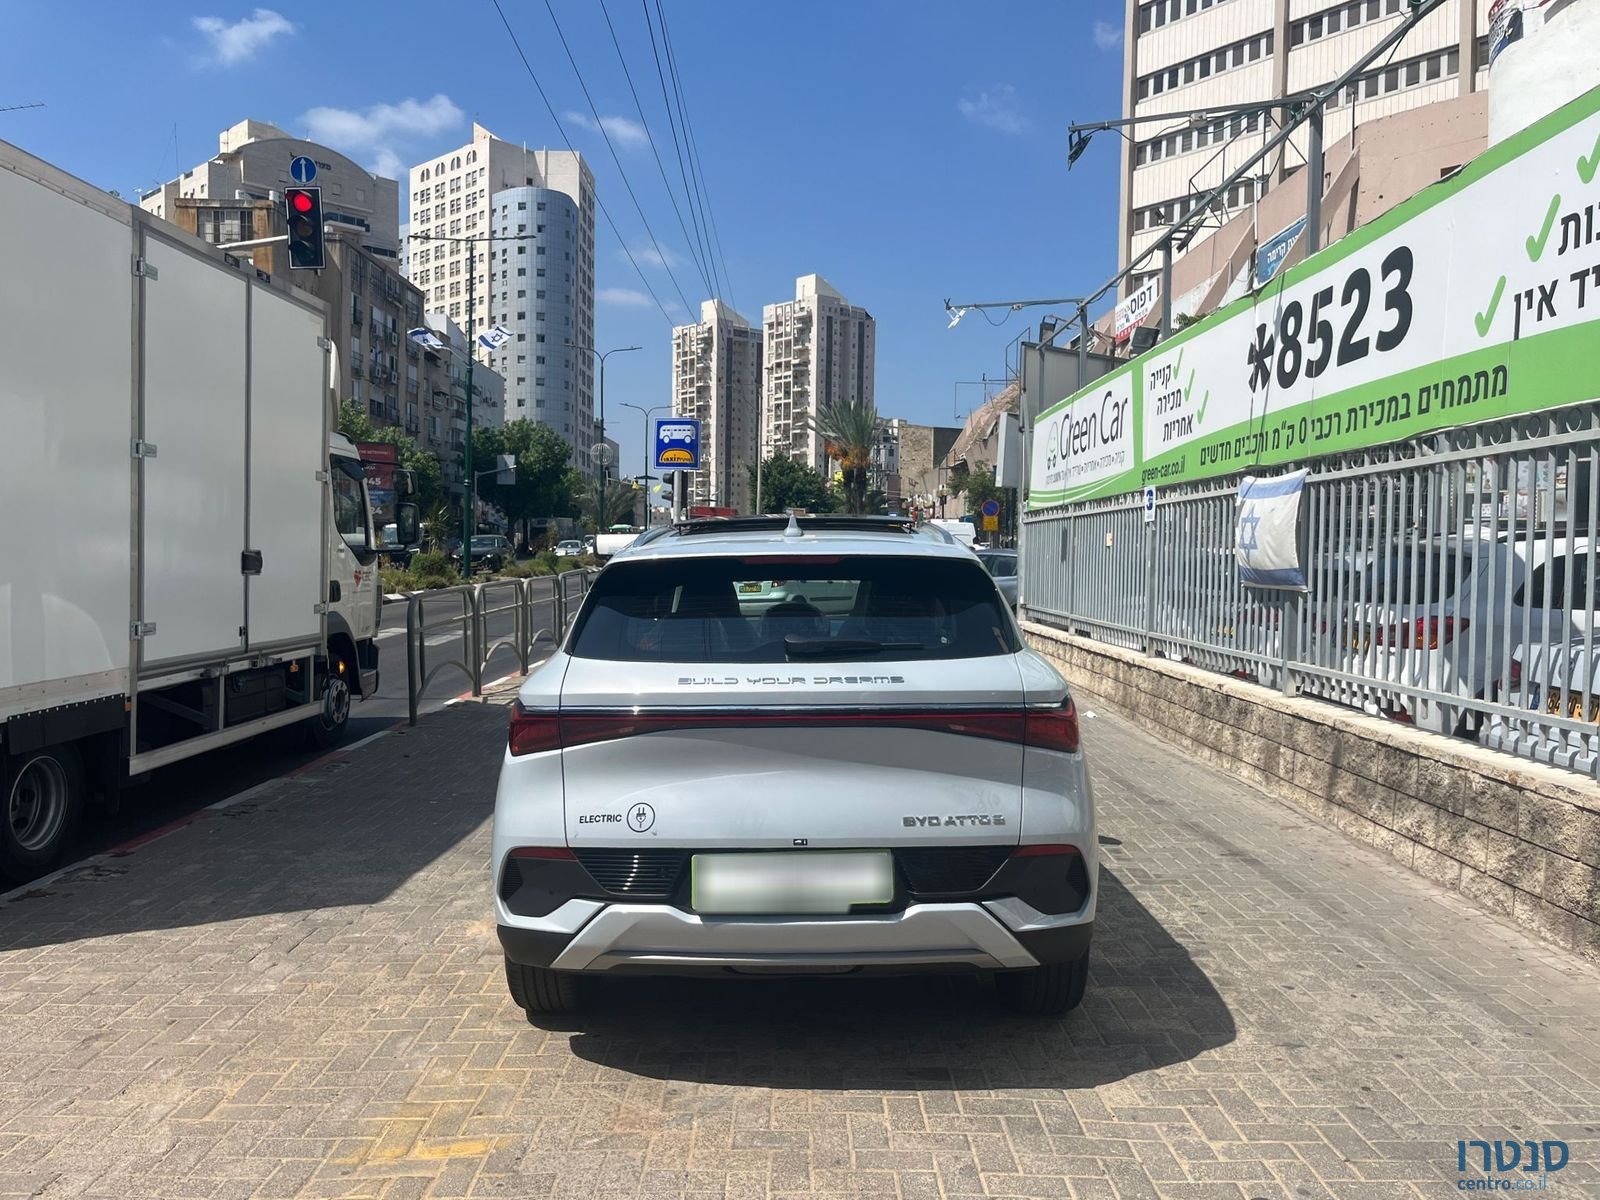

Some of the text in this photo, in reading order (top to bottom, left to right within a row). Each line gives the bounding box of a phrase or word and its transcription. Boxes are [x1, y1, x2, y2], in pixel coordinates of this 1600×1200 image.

[1558, 202, 1600, 256] ות
[1267, 242, 1286, 264] קדימה
[1130, 285, 1152, 314] דפוס
[1513, 278, 1559, 341] אין
[1150, 364, 1172, 391] קנייה
[1417, 364, 1508, 415] מתמחים
[1156, 388, 1182, 416] מכירה
[1345, 392, 1411, 434] במכירת
[1060, 390, 1128, 460] Green Car
[1163, 413, 1194, 443] אחריות
[1299, 416, 1307, 444] 0
[1311, 412, 1342, 441] רכבי
[1200, 440, 1231, 466] חדשים
[1234, 430, 1269, 459] ורכבים
[1141, 454, 1186, 486] green-car.co.il
[677, 675, 905, 685] BUILD YOUR DREAMS
[579, 814, 622, 824] ELECTRIC
